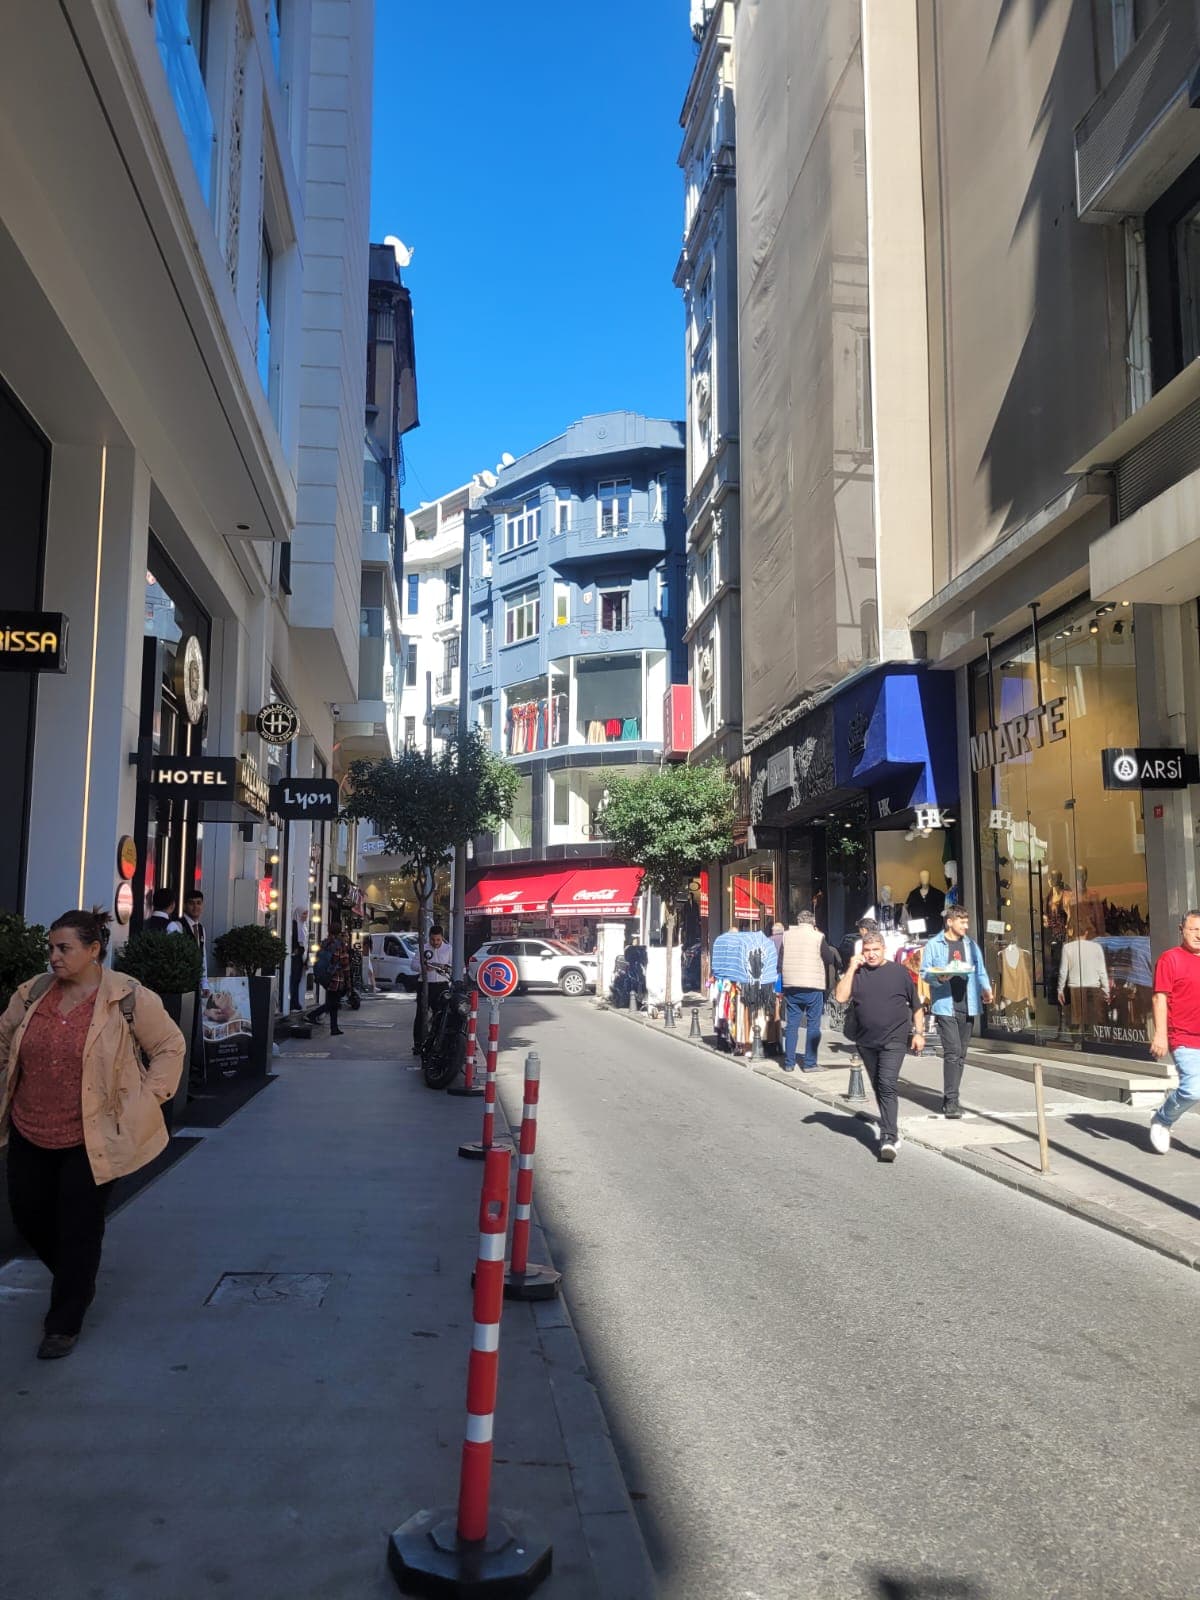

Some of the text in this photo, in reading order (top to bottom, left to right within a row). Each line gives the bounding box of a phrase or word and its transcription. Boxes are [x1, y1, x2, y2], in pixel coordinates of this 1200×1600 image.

[0, 625, 57, 653] İSSA
[259, 704, 296, 719] HALLMARK
[970, 696, 1067, 773] MIARTE
[158, 769, 227, 785] HOTEL
[283, 788, 332, 809] Lyon
[1093, 1024, 1145, 1042] NEW SEASON
